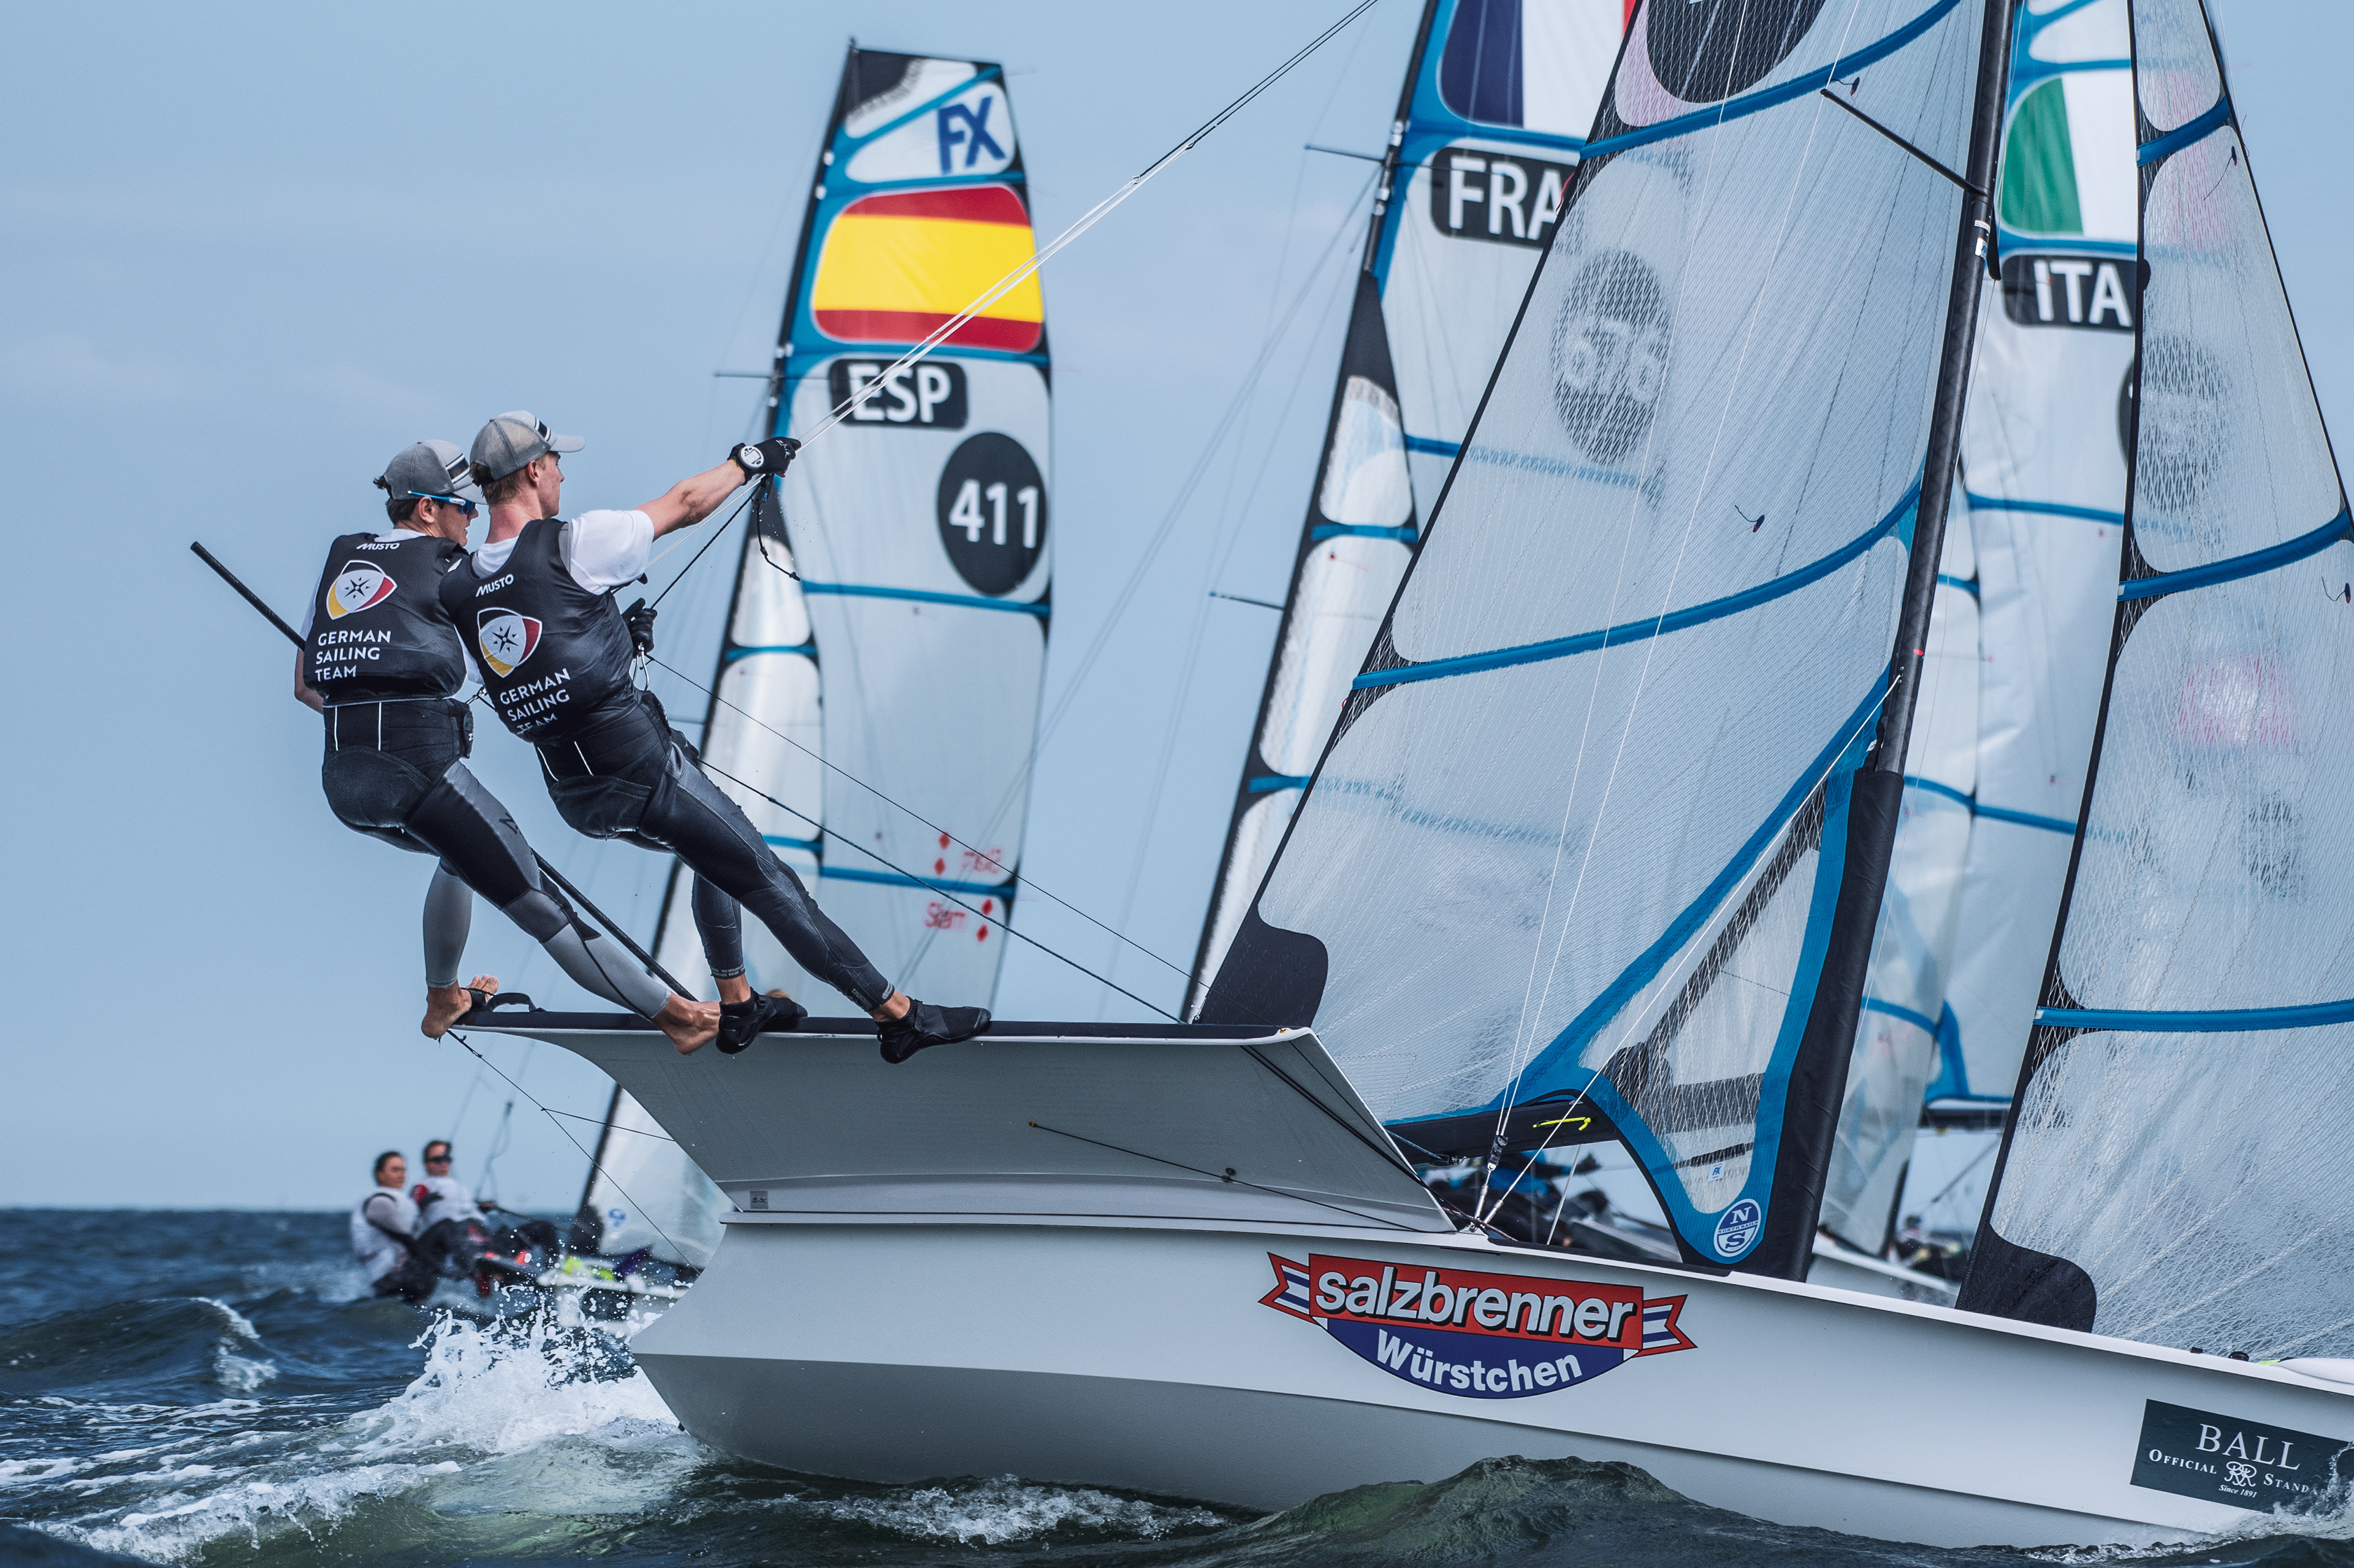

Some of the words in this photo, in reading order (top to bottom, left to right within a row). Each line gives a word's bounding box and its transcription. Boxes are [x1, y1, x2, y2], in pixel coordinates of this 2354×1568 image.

[937, 96, 1006, 175] FX
[1449, 157, 1564, 240] FRA
[2033, 259, 2133, 327] ITA
[848, 363, 951, 422] ESP
[949, 479, 1038, 549] 411
[476, 574, 514, 597] MUSTO
[318, 630, 391, 646] GERMAN
[316, 647, 380, 664] SAILING
[315, 665, 357, 682] TEAM
[500, 668, 571, 704] GERMAN
[507, 689, 570, 721] SAILING
[1730, 1206, 1752, 1225] N
[1725, 1231, 1746, 1249] S
[1315, 1265, 1637, 1341] salzbrenner
[1377, 1329, 1582, 1391] Würstchen
[2149, 1449, 2217, 1474] OFFICIAL
[2195, 1423, 2300, 1470] BALL
[2219, 1484, 2239, 1494] Since
[2240, 1488, 2257, 1498] 1891
